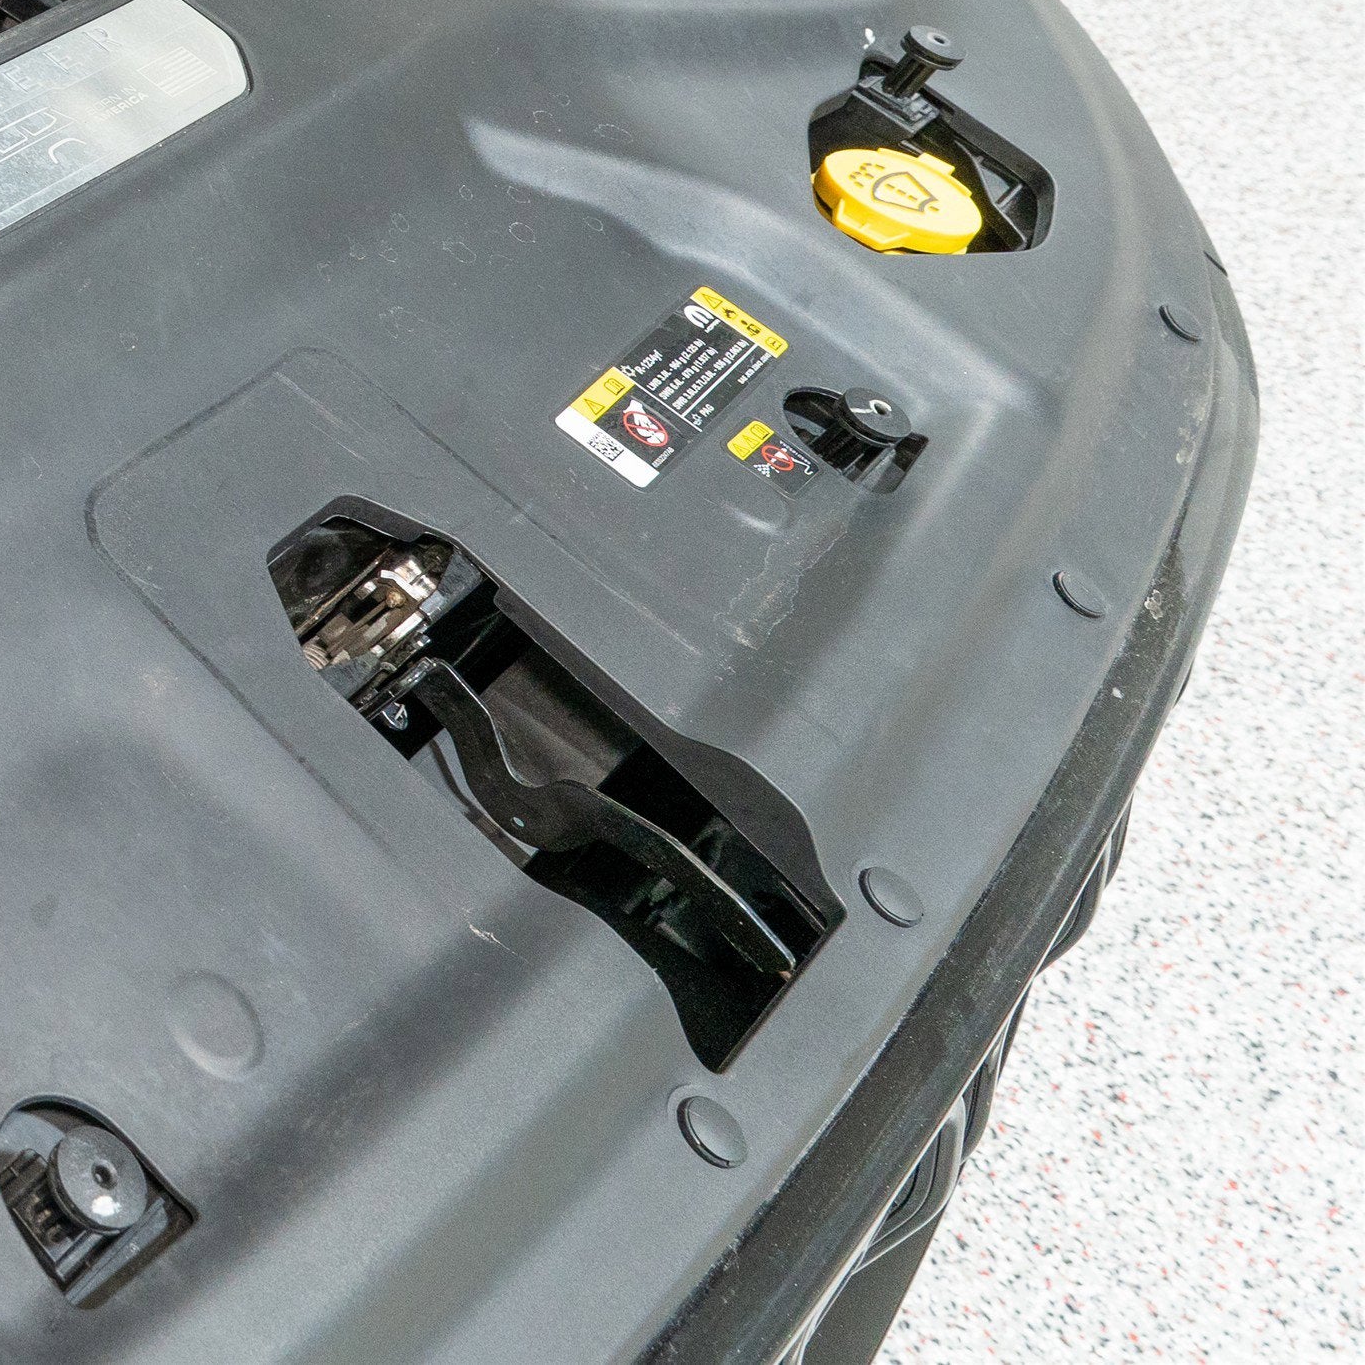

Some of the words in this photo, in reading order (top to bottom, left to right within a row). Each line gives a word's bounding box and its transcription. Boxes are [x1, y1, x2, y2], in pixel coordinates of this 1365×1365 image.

[120, 83, 136, 96] IN
[633, 348, 665, 376] R-1234yf
[646, 376, 662, 391] LWB
[658, 385, 674, 400] SWB
[671, 395, 688, 410] SWB
[698, 403, 715, 417] PAG
